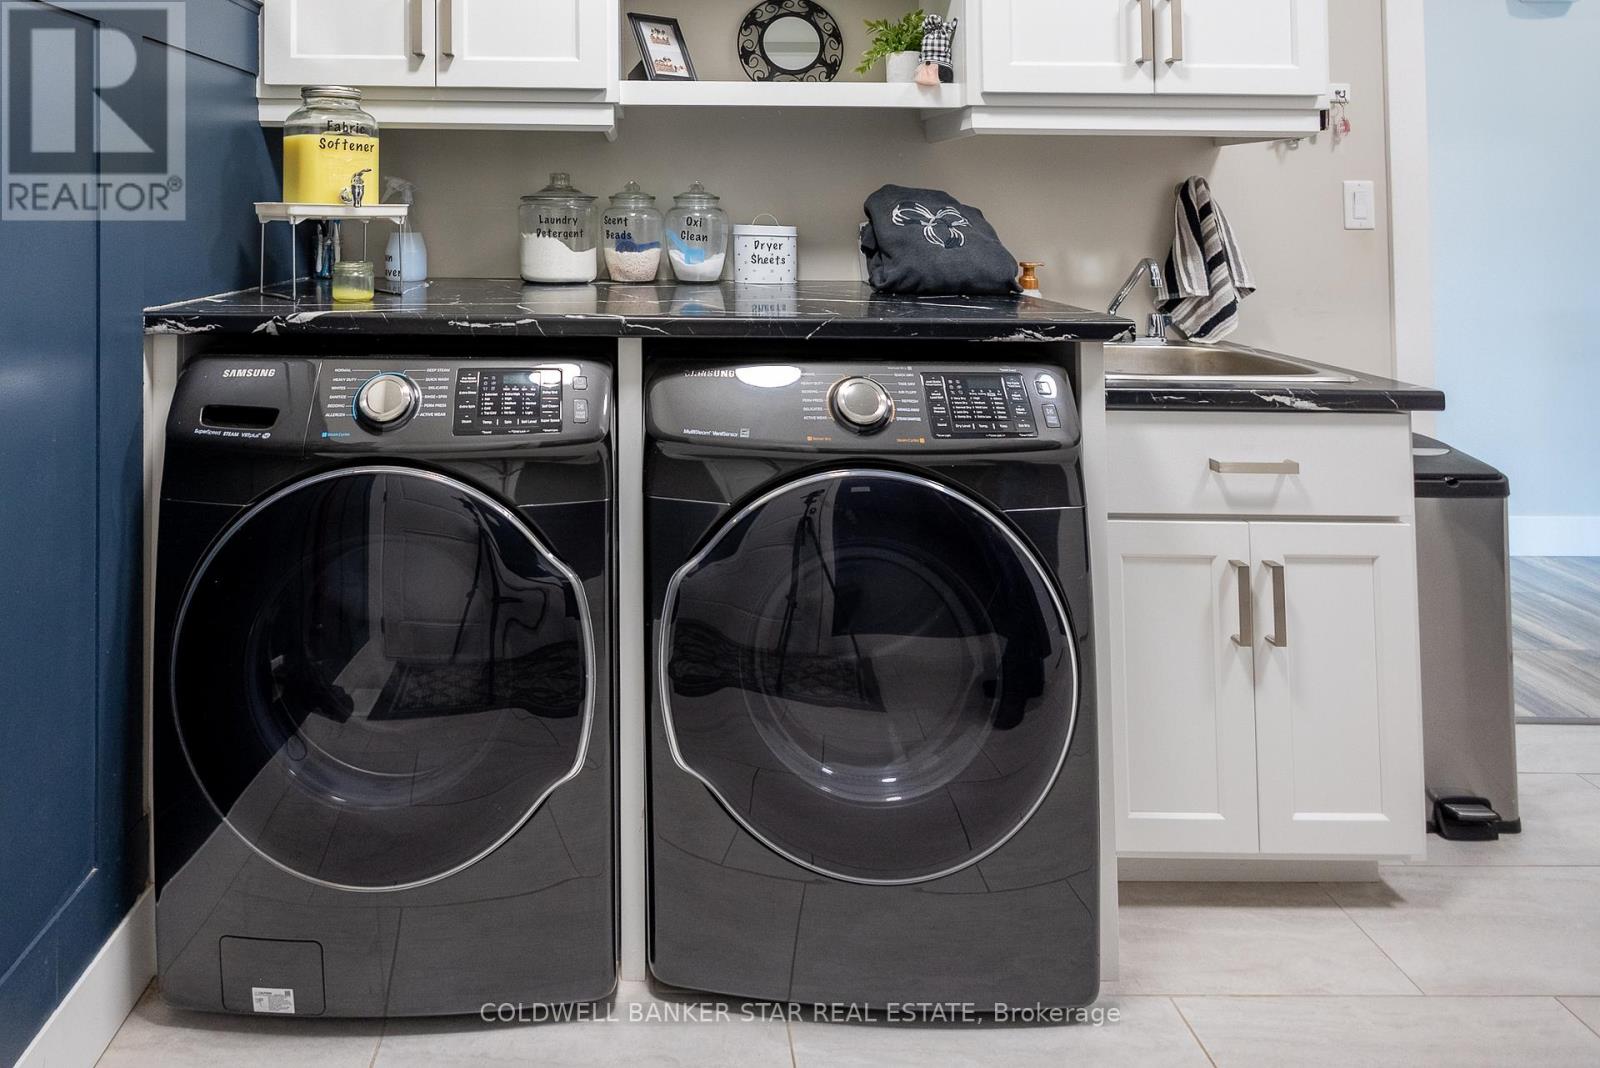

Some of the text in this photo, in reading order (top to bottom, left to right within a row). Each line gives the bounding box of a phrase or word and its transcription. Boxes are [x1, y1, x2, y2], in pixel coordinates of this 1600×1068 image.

[326, 119, 366, 134] Fabric
[318, 137, 375, 153] Softener
[538, 214, 578, 227] Laundry
[603, 215, 628, 227] Scent
[686, 216, 702, 228] Oxi
[536, 228, 584, 239] Detergent
[605, 230, 632, 240] Beads
[680, 230, 708, 242] Clean
[753, 239, 784, 253] Dryer
[750, 253, 786, 266] Sheets
[222, 368, 276, 378] SAMSUNG
